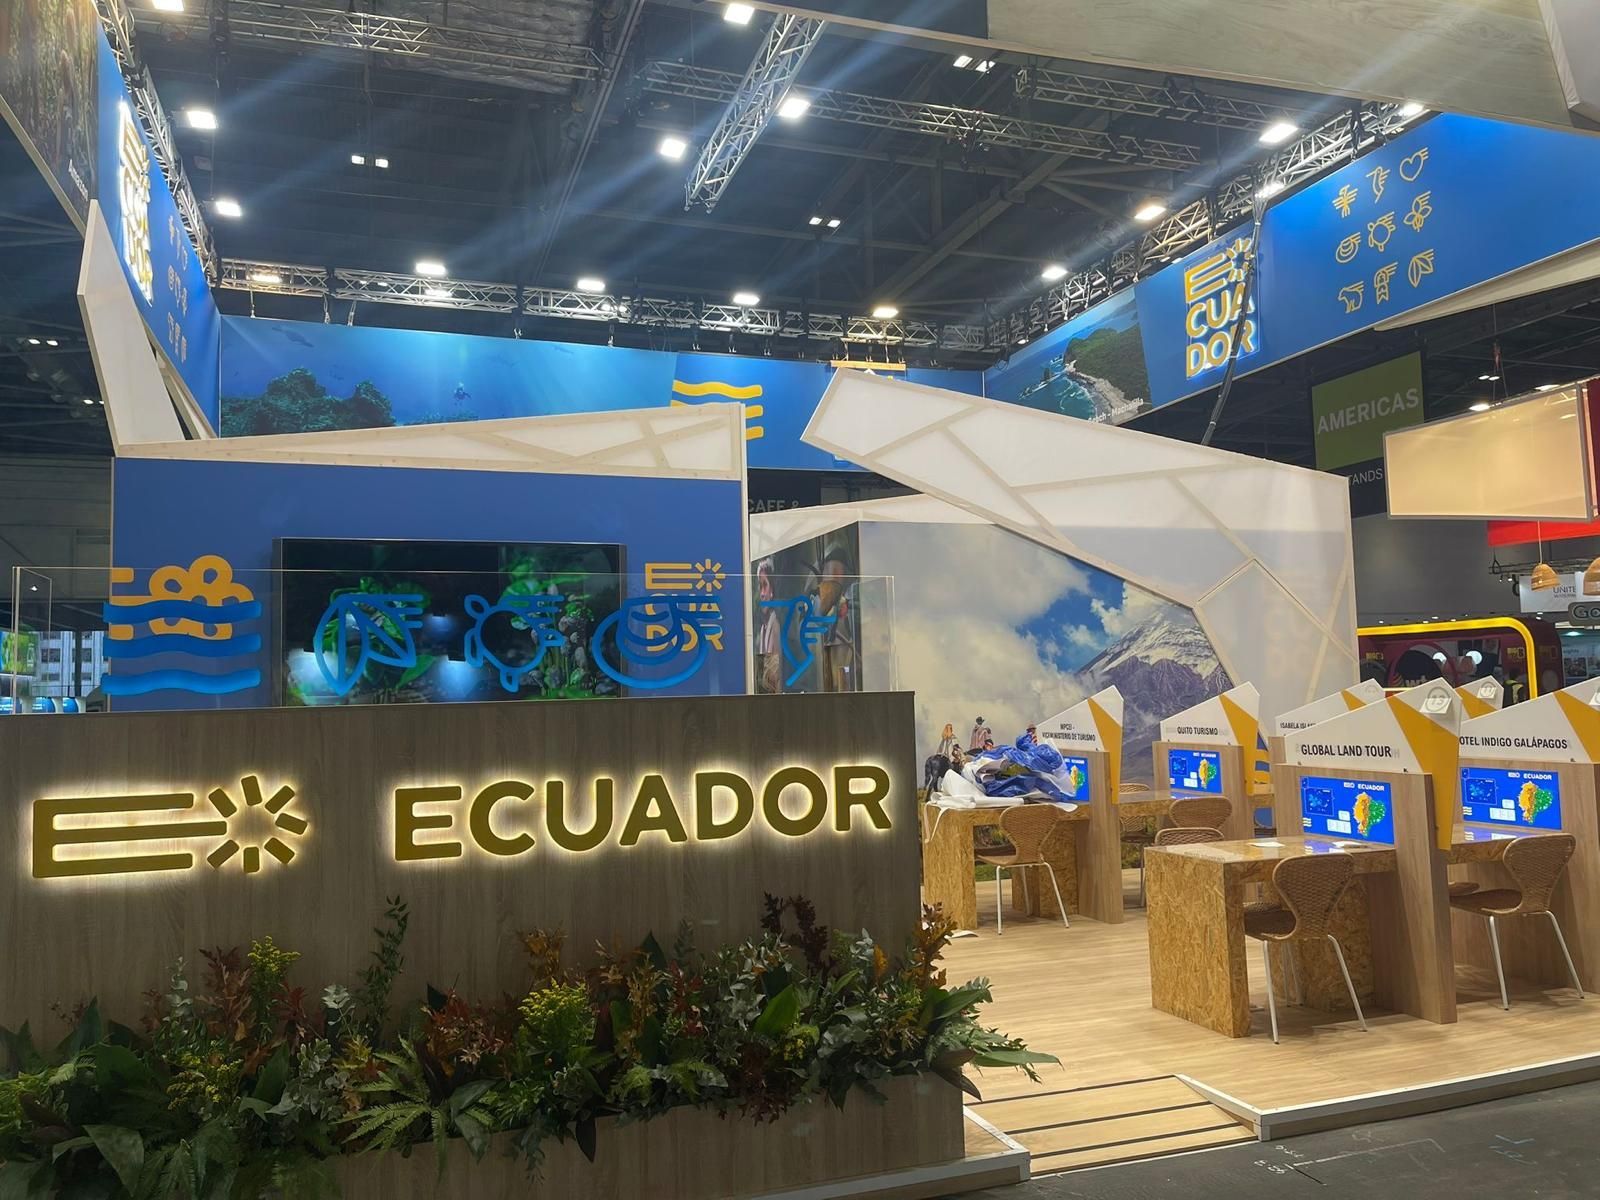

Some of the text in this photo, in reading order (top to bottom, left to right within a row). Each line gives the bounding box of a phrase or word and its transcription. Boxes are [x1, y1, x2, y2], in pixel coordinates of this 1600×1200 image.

[1317, 388, 1419, 434] AMERICAS
[1349, 468, 1384, 486] ANDS
[1177, 726, 1218, 735] QUITO TURISMO
[1078, 733, 1096, 741] TURISMO
[1481, 737, 1512, 747] INDIGO
[1514, 737, 1567, 749] GALÁPAGOS
[1301, 744, 1392, 757] GLOBAL LAND TOUR
[1358, 783, 1384, 791] ECUADOR
[395, 765, 892, 861] ECUADOR
